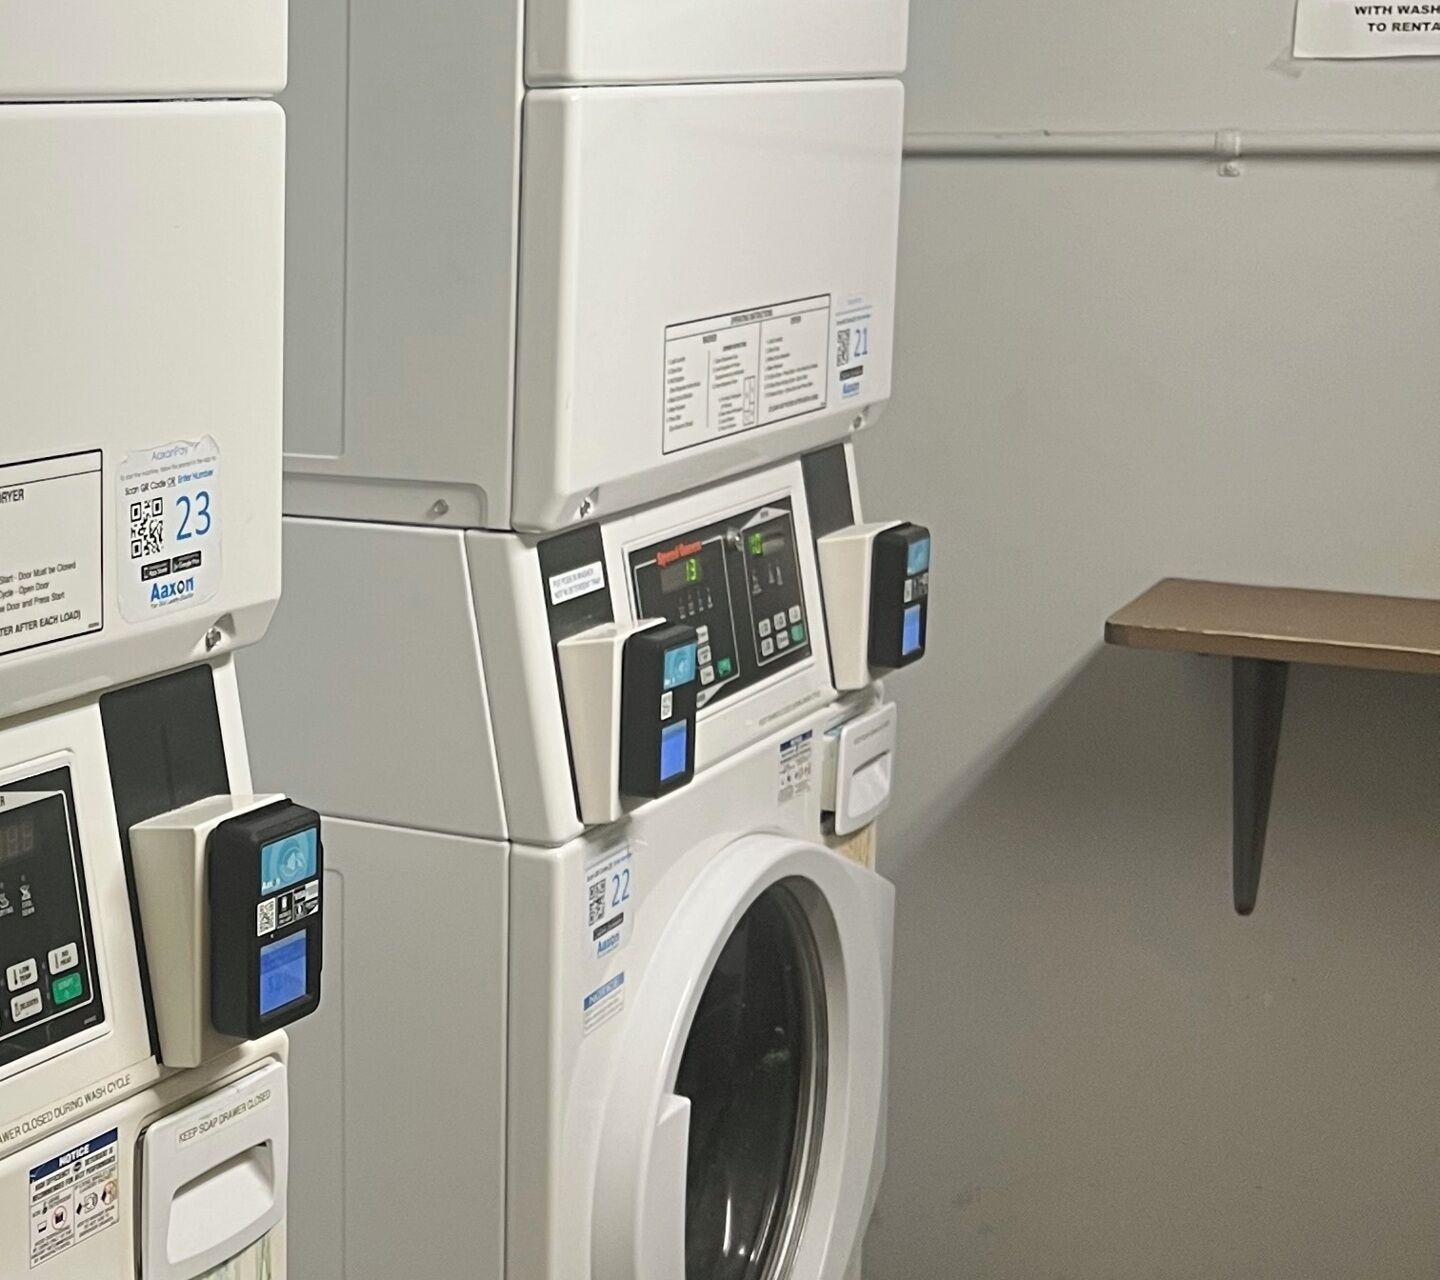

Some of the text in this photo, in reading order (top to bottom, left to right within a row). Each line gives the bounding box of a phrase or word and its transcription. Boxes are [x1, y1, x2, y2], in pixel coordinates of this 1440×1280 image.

[1355, 5, 1440, 15] WITH WASH
[1368, 22, 1440, 32] TO RENTA
[854, 328, 867, 357] 21
[176, 491, 212, 541] 23
[151, 577, 193, 602] Aaxon
[15, 620, 37, 632] AFTER
[40, 615, 58, 627] EACH
[612, 868, 630, 908] 22
[22, 1110, 54, 1134] CLOSED
[54, 1097, 83, 1118] DURING
[84, 1086, 106, 1103] WASH
[107, 1074, 131, 1094] CYCLE
[179, 1127, 197, 1143] KEEP
[219, 1103, 246, 1125] DRAWER
[247, 1089, 271, 1109] CLOSED
[59, 1144, 89, 1167] NOTICE
